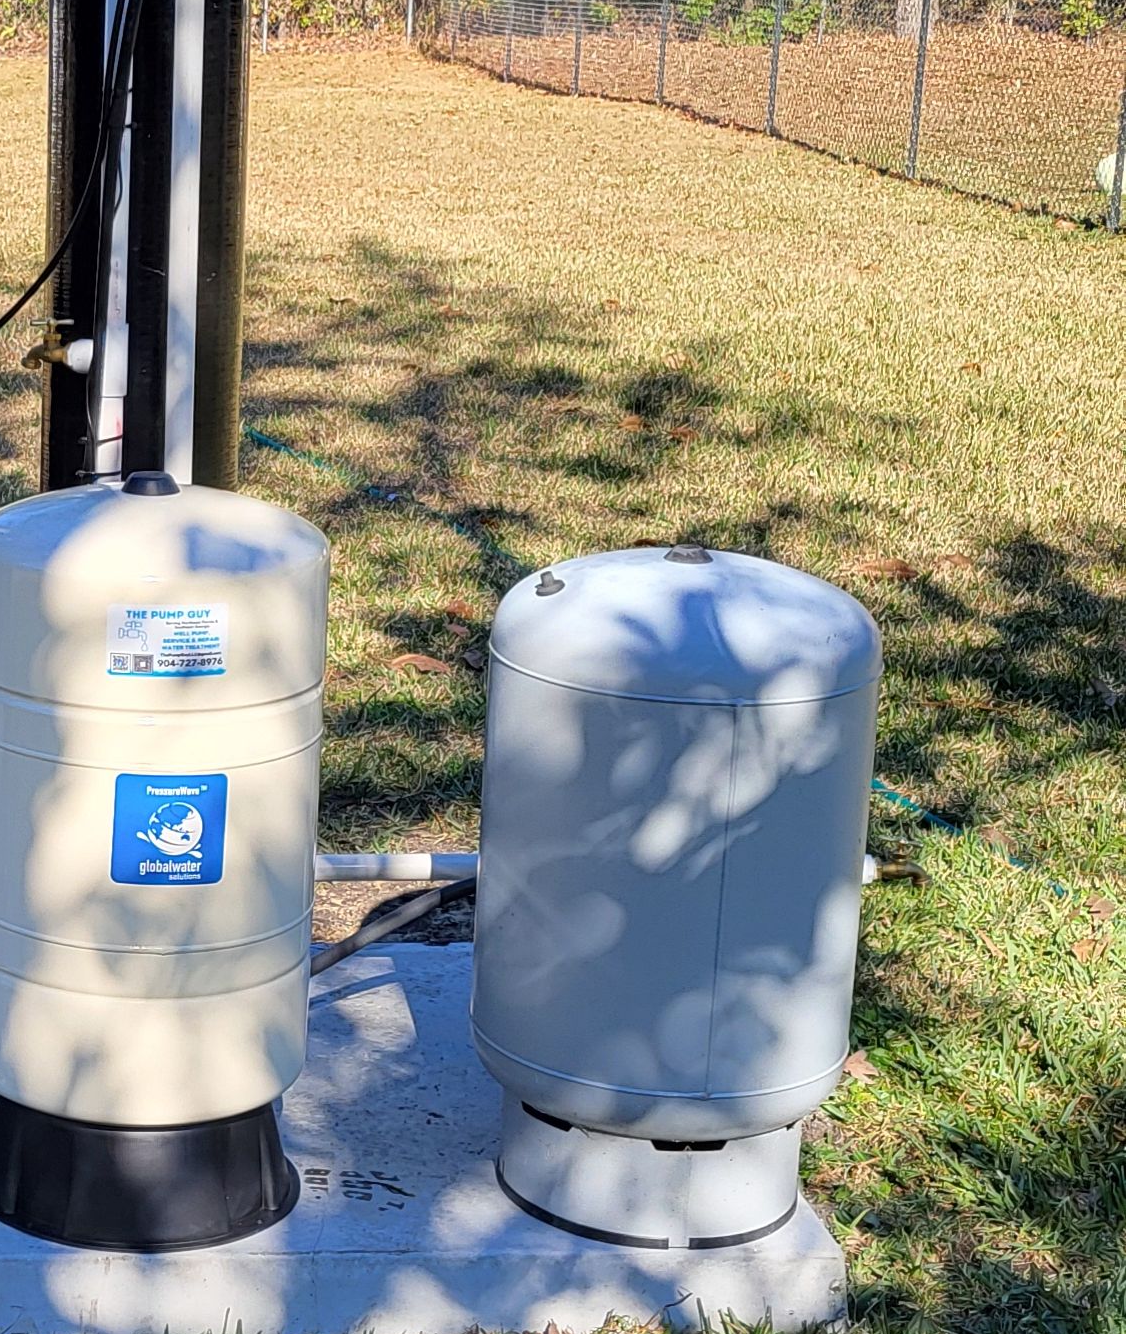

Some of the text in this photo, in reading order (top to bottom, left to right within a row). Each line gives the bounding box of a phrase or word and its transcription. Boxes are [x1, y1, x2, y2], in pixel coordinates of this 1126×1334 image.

[126, 609, 211, 619] THE PUMP GUY
[157, 657, 224, 667] 904-727-8976
[139, 859, 202, 875] globalwater
[168, 873, 201, 881] solutions
